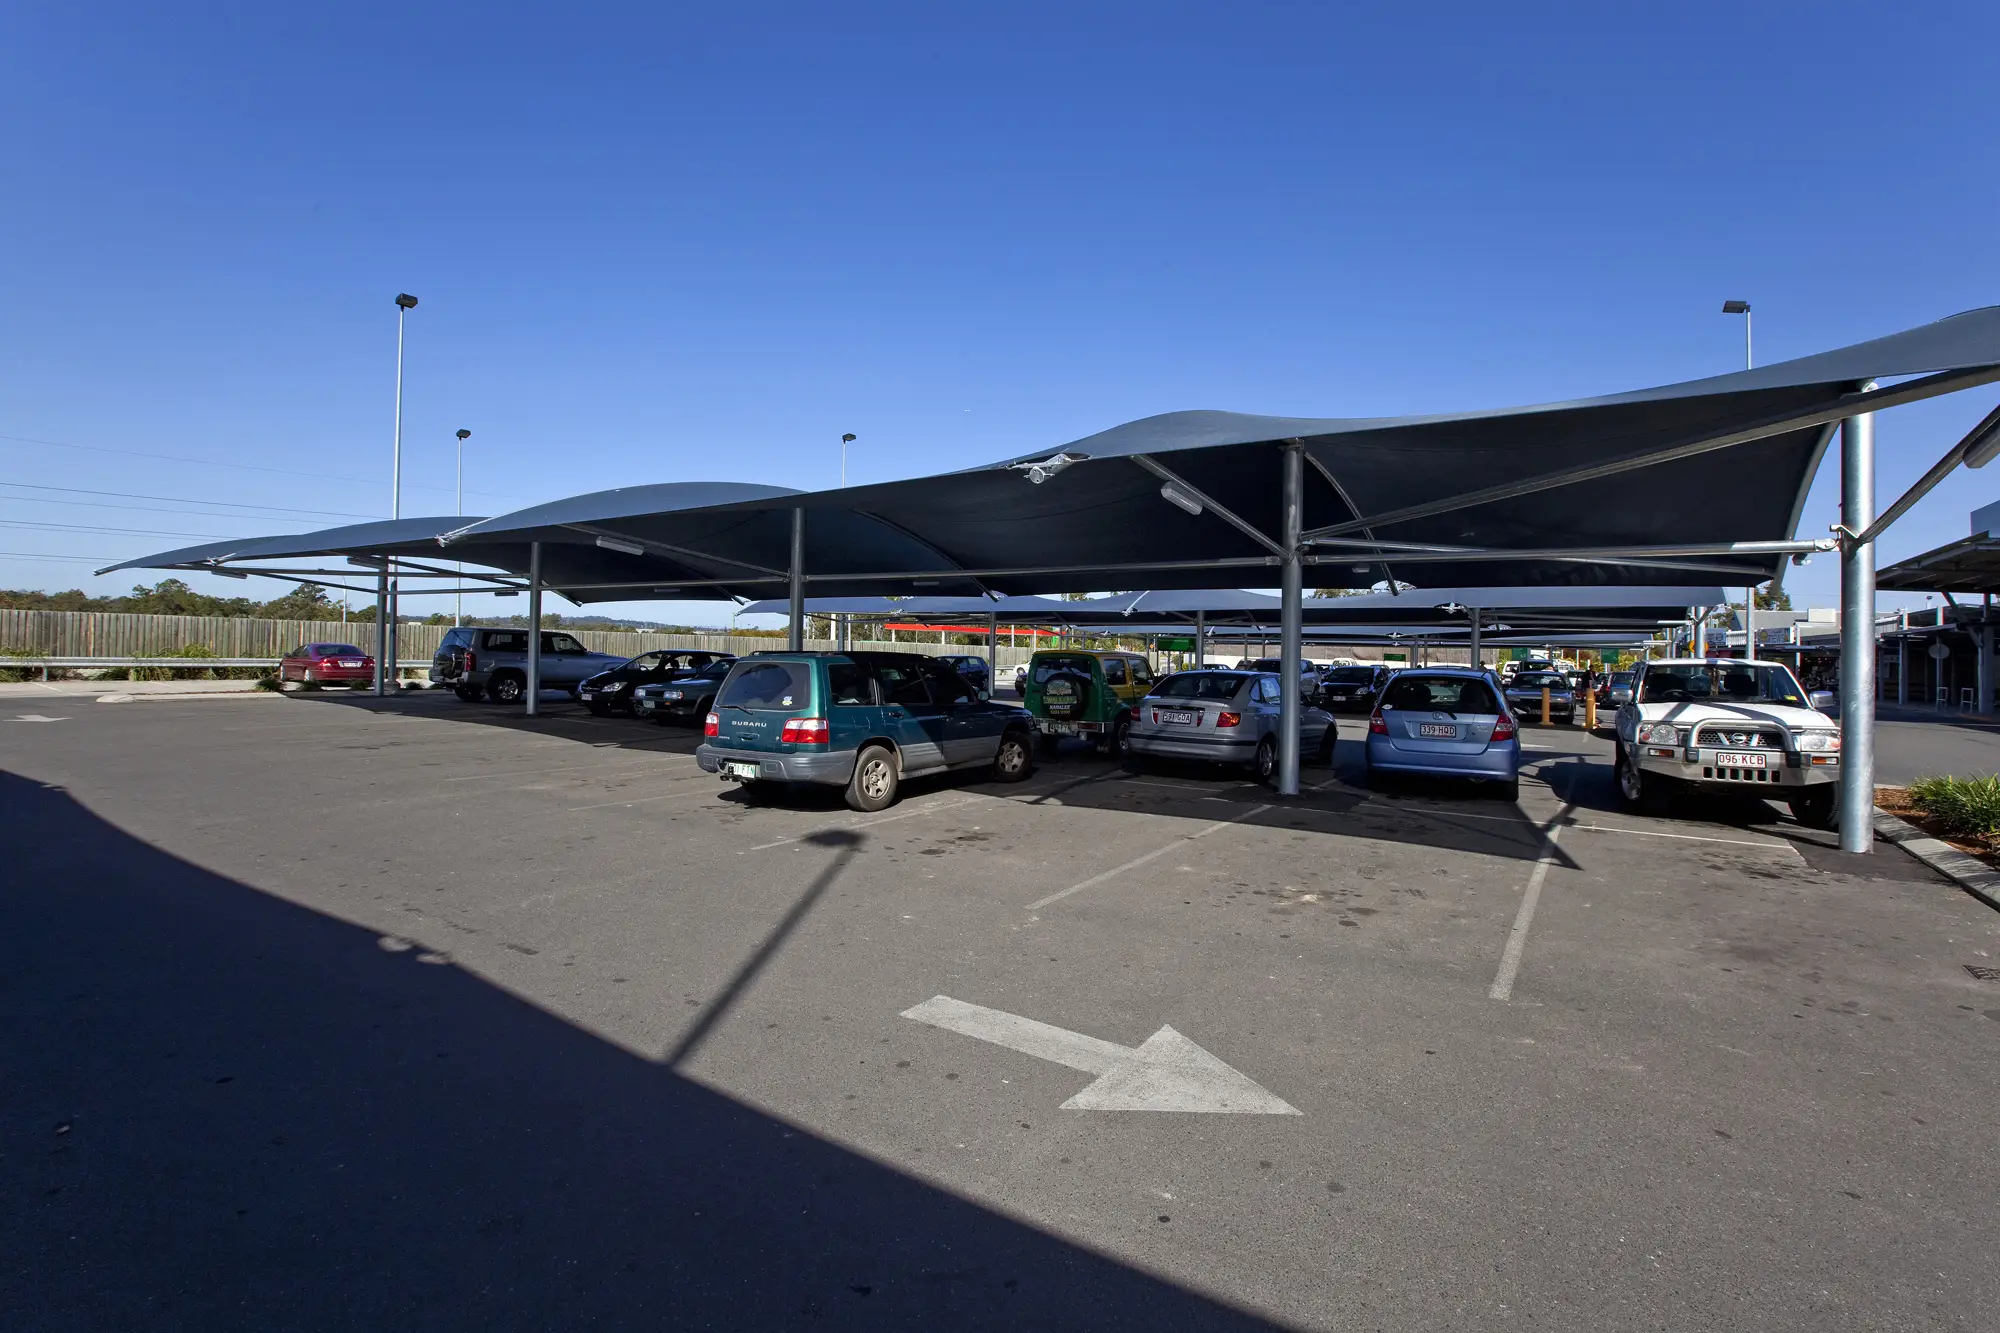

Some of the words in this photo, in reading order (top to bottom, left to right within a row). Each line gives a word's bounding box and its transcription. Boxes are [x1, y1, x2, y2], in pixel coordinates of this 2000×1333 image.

[731, 720, 767, 728] SUBARU
[1421, 725, 1436, 734] 339
[1438, 726, 1455, 735] HQD
[1719, 754, 1738, 764] 096
[1741, 755, 1764, 765] KCB
